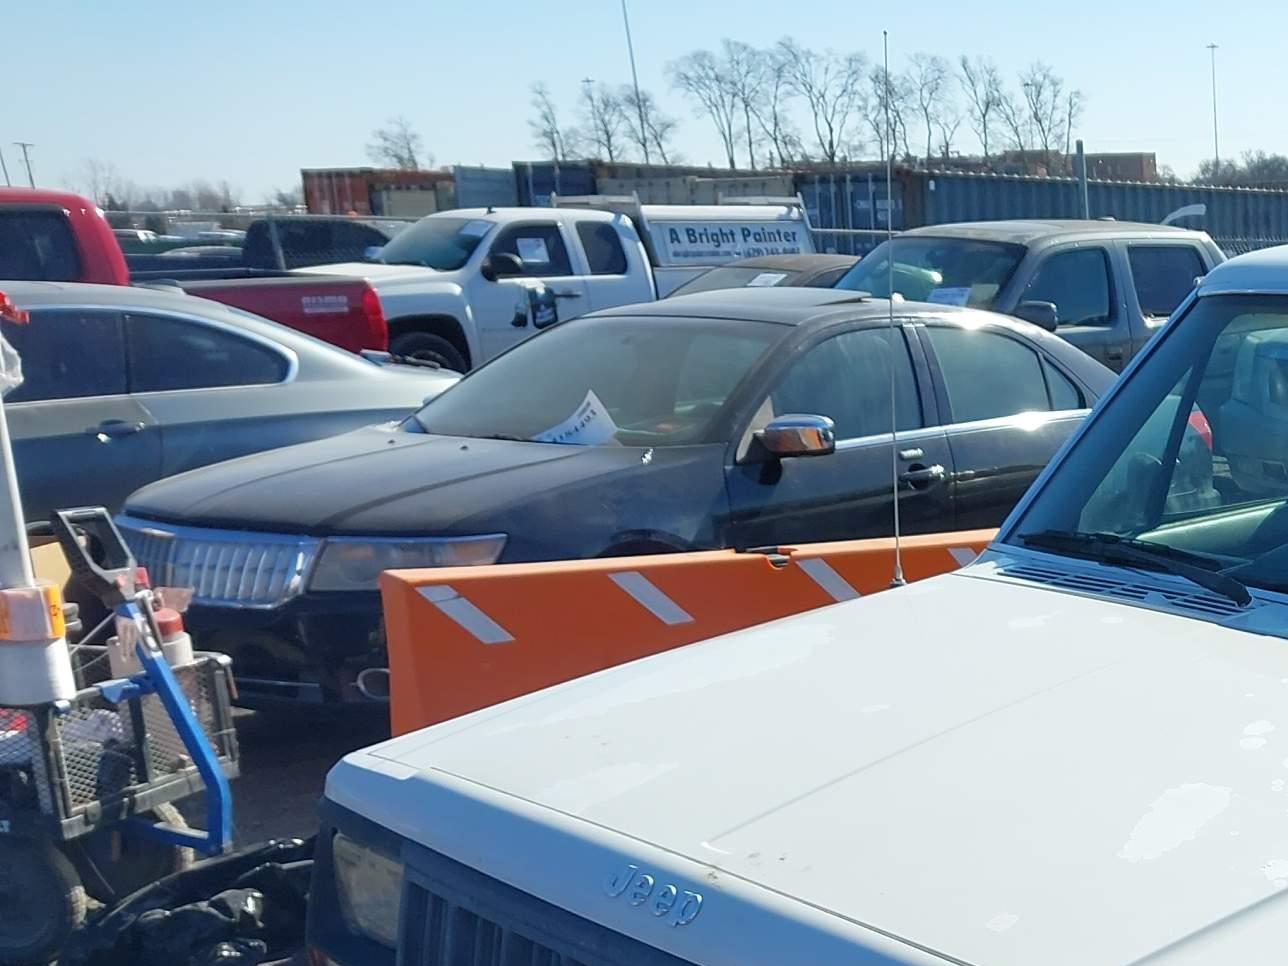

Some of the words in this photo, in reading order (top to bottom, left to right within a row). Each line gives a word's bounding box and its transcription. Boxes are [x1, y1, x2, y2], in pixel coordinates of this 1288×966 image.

[669, 228, 681, 244] A
[686, 227, 736, 247] Bright
[741, 227, 797, 243] Painter
[603, 864, 704, 928] Jeep
